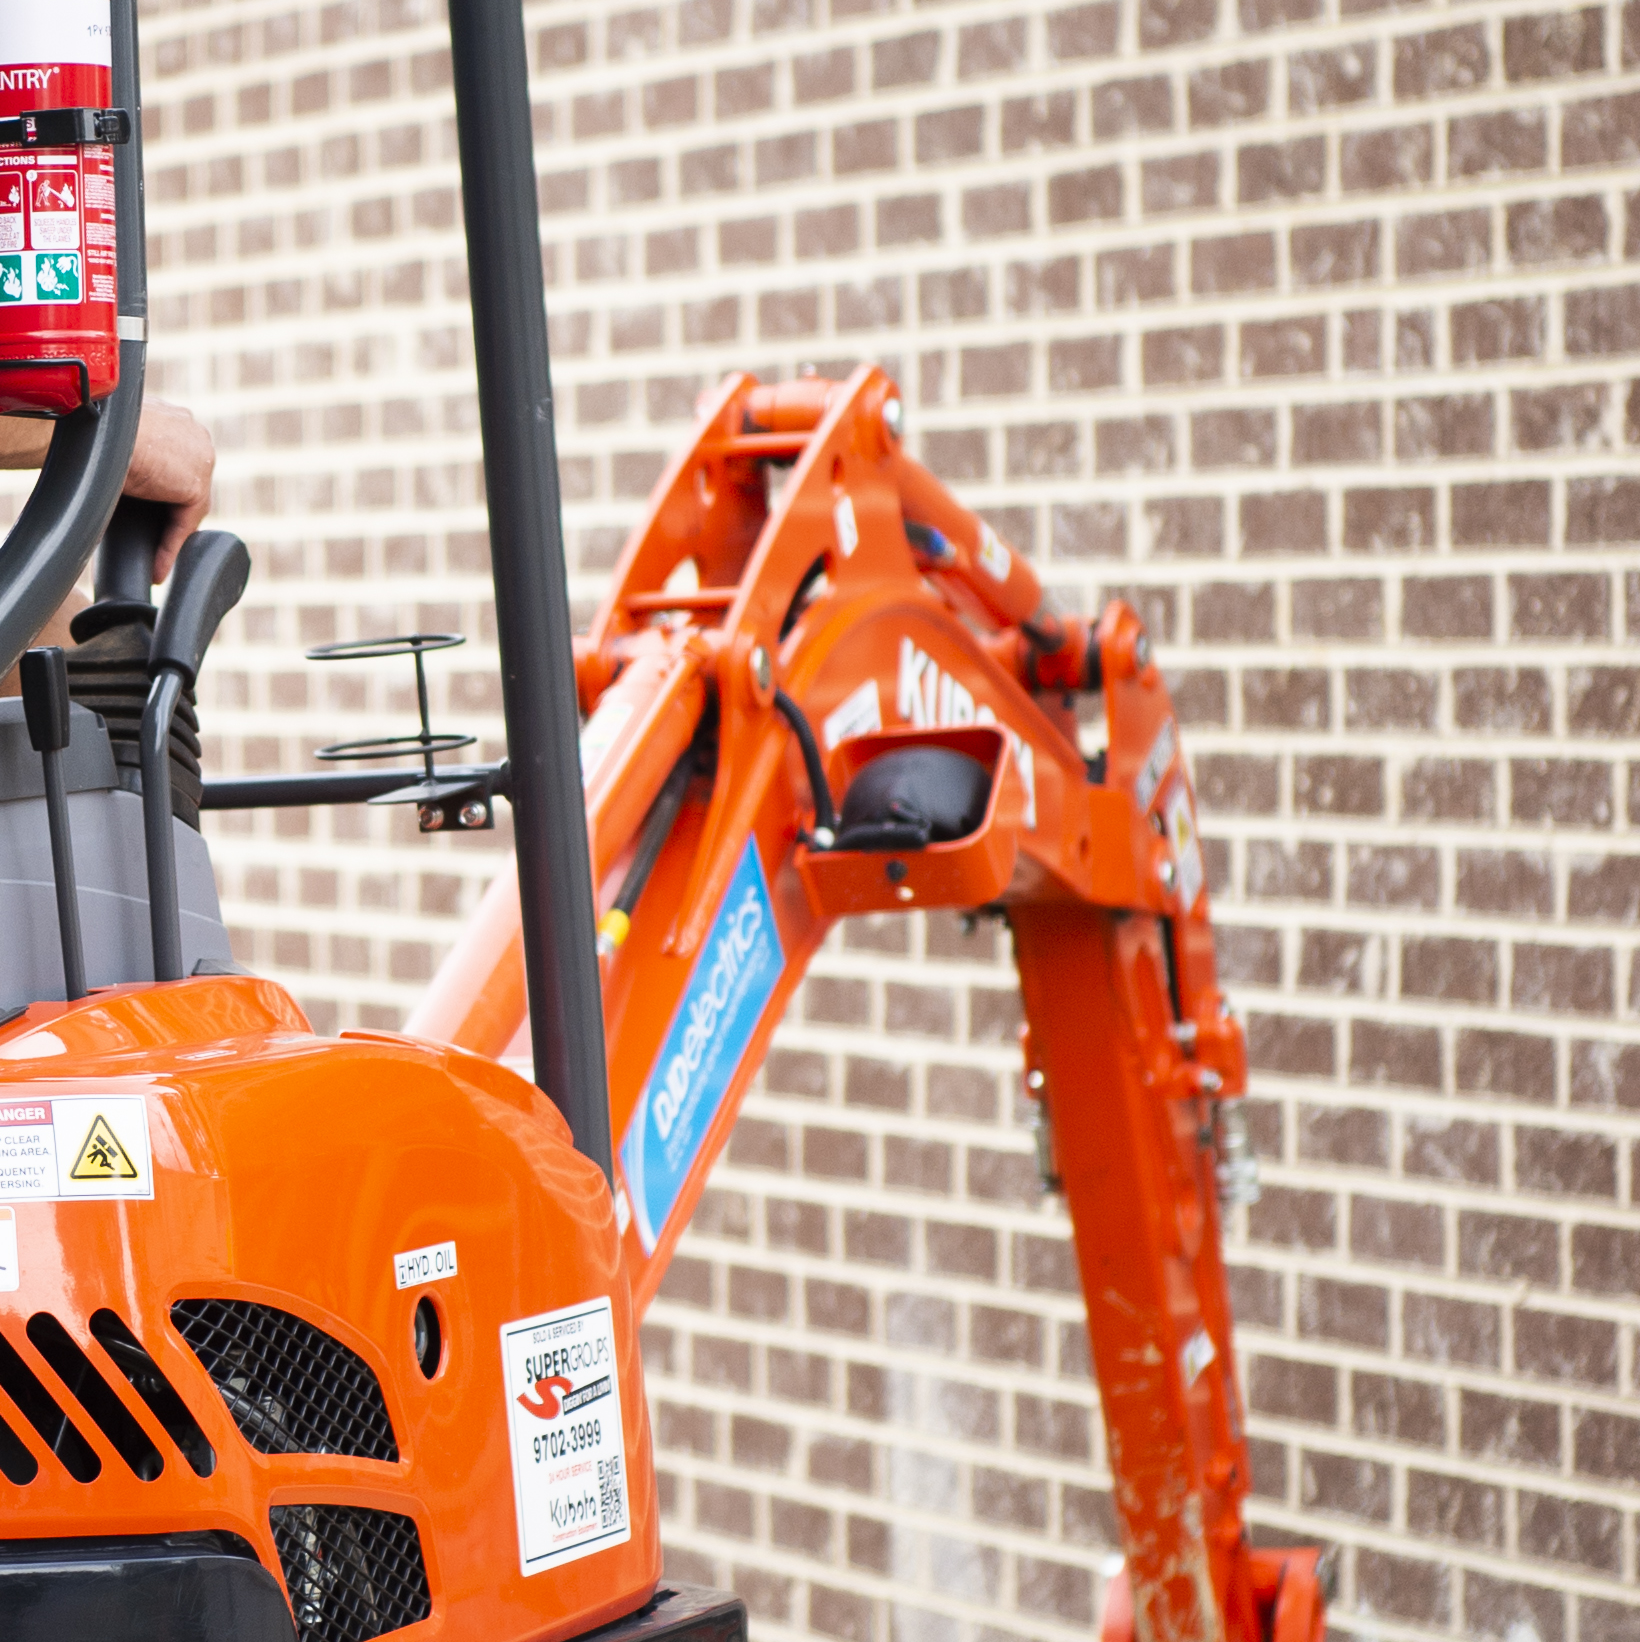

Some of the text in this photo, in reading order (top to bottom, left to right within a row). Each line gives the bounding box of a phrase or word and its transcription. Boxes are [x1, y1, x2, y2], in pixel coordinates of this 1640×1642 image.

[4, 1134, 41, 1146] CLEAR
[407, 1249, 455, 1280] HYD. OIL
[525, 1336, 610, 1384] SUPERGROUPS
[533, 1418, 602, 1464] 9702-3999
